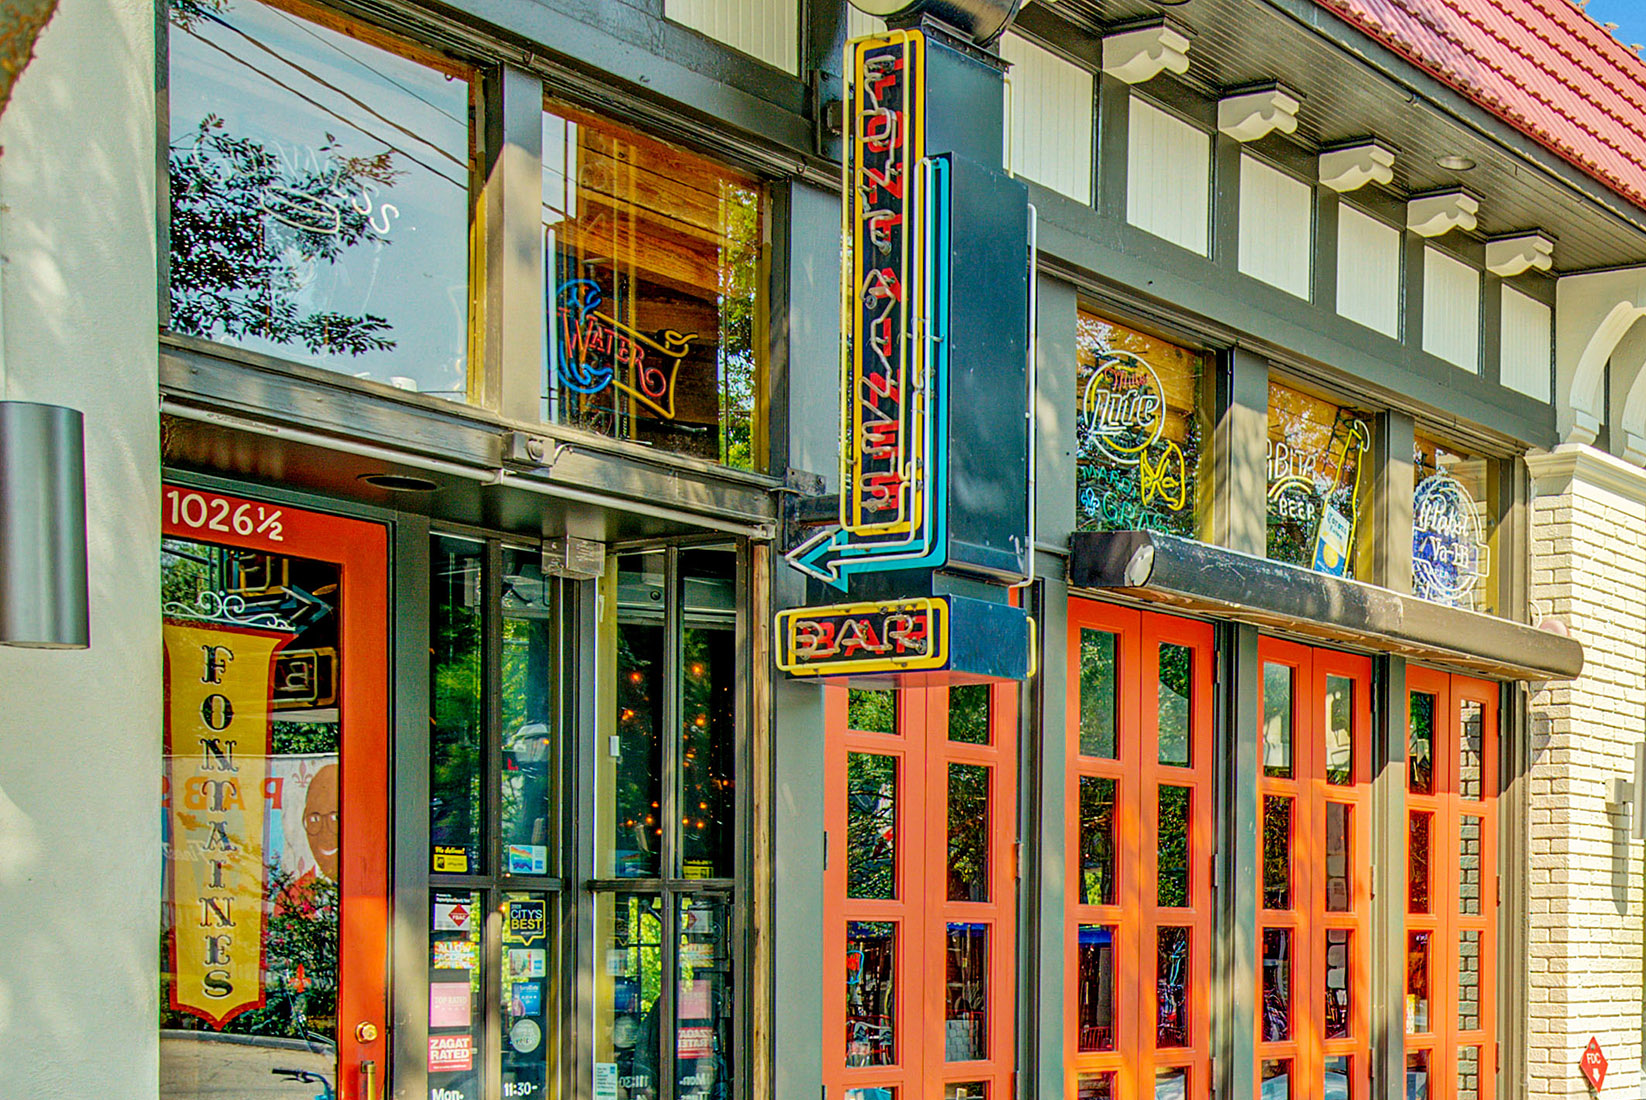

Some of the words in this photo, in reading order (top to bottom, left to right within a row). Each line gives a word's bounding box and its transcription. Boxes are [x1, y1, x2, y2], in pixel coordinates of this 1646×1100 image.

[857, 55, 904, 512] FONTAINES
[557, 308, 667, 398] WATER
[1090, 388, 1160, 434] Lite
[1279, 500, 1315, 521] BEER
[788, 613, 928, 660] BAR
[199, 645, 239, 1000] FONTAINES
[510, 909, 543, 919] CITY'S
[511, 919, 543, 930] BEST
[430, 1037, 470, 1049] ZAGAT
[430, 1049, 470, 1060] RATED
[1586, 1052, 1601, 1064] FDC
